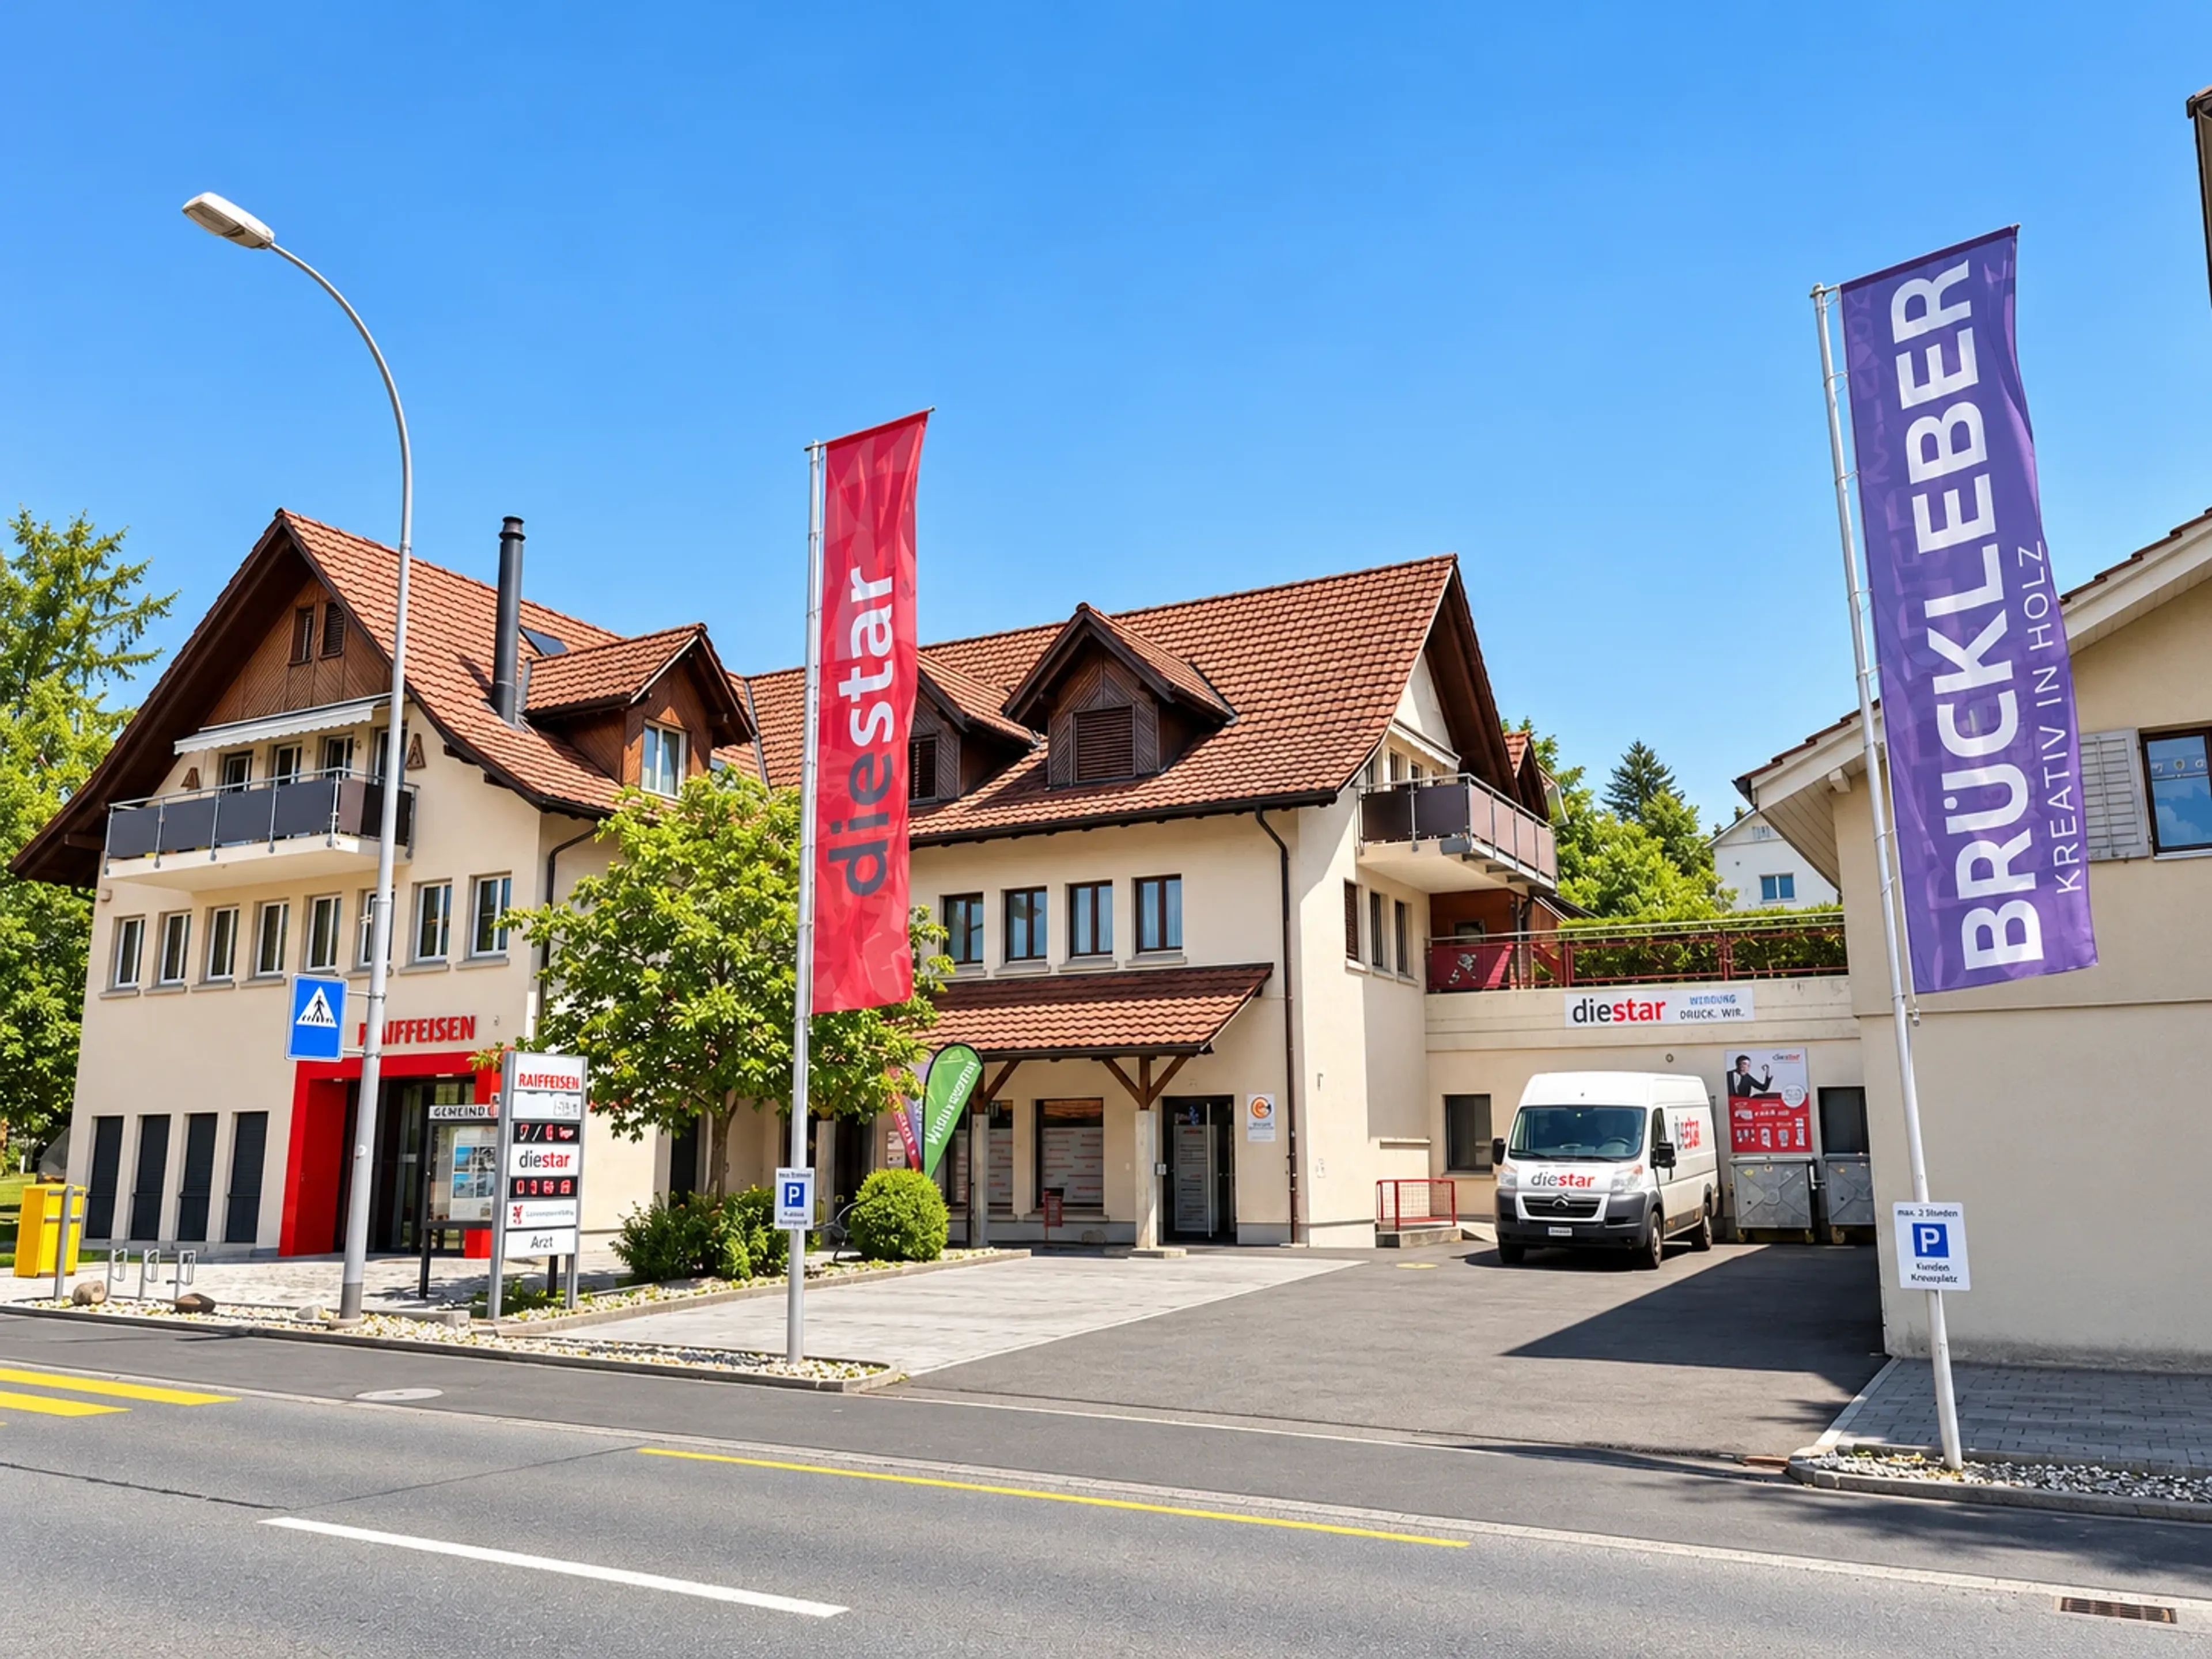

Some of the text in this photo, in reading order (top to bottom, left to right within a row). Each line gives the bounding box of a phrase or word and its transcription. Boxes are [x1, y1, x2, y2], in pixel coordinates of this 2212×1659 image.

[1891, 260, 2044, 970] BRÜCKLEBER
[2018, 540, 2082, 894] KREATIV IN HOLZ
[828, 566, 893, 897] diestar
[1573, 998, 1666, 1023] diestar
[518, 1073, 579, 1090] RAIFFEISEN
[520, 1150, 570, 1168] diestar
[1531, 1172, 1596, 1188] diestar
[789, 1186, 800, 1205] P
[530, 1236, 553, 1248] Arzt
[1920, 1228, 1940, 1253] P
